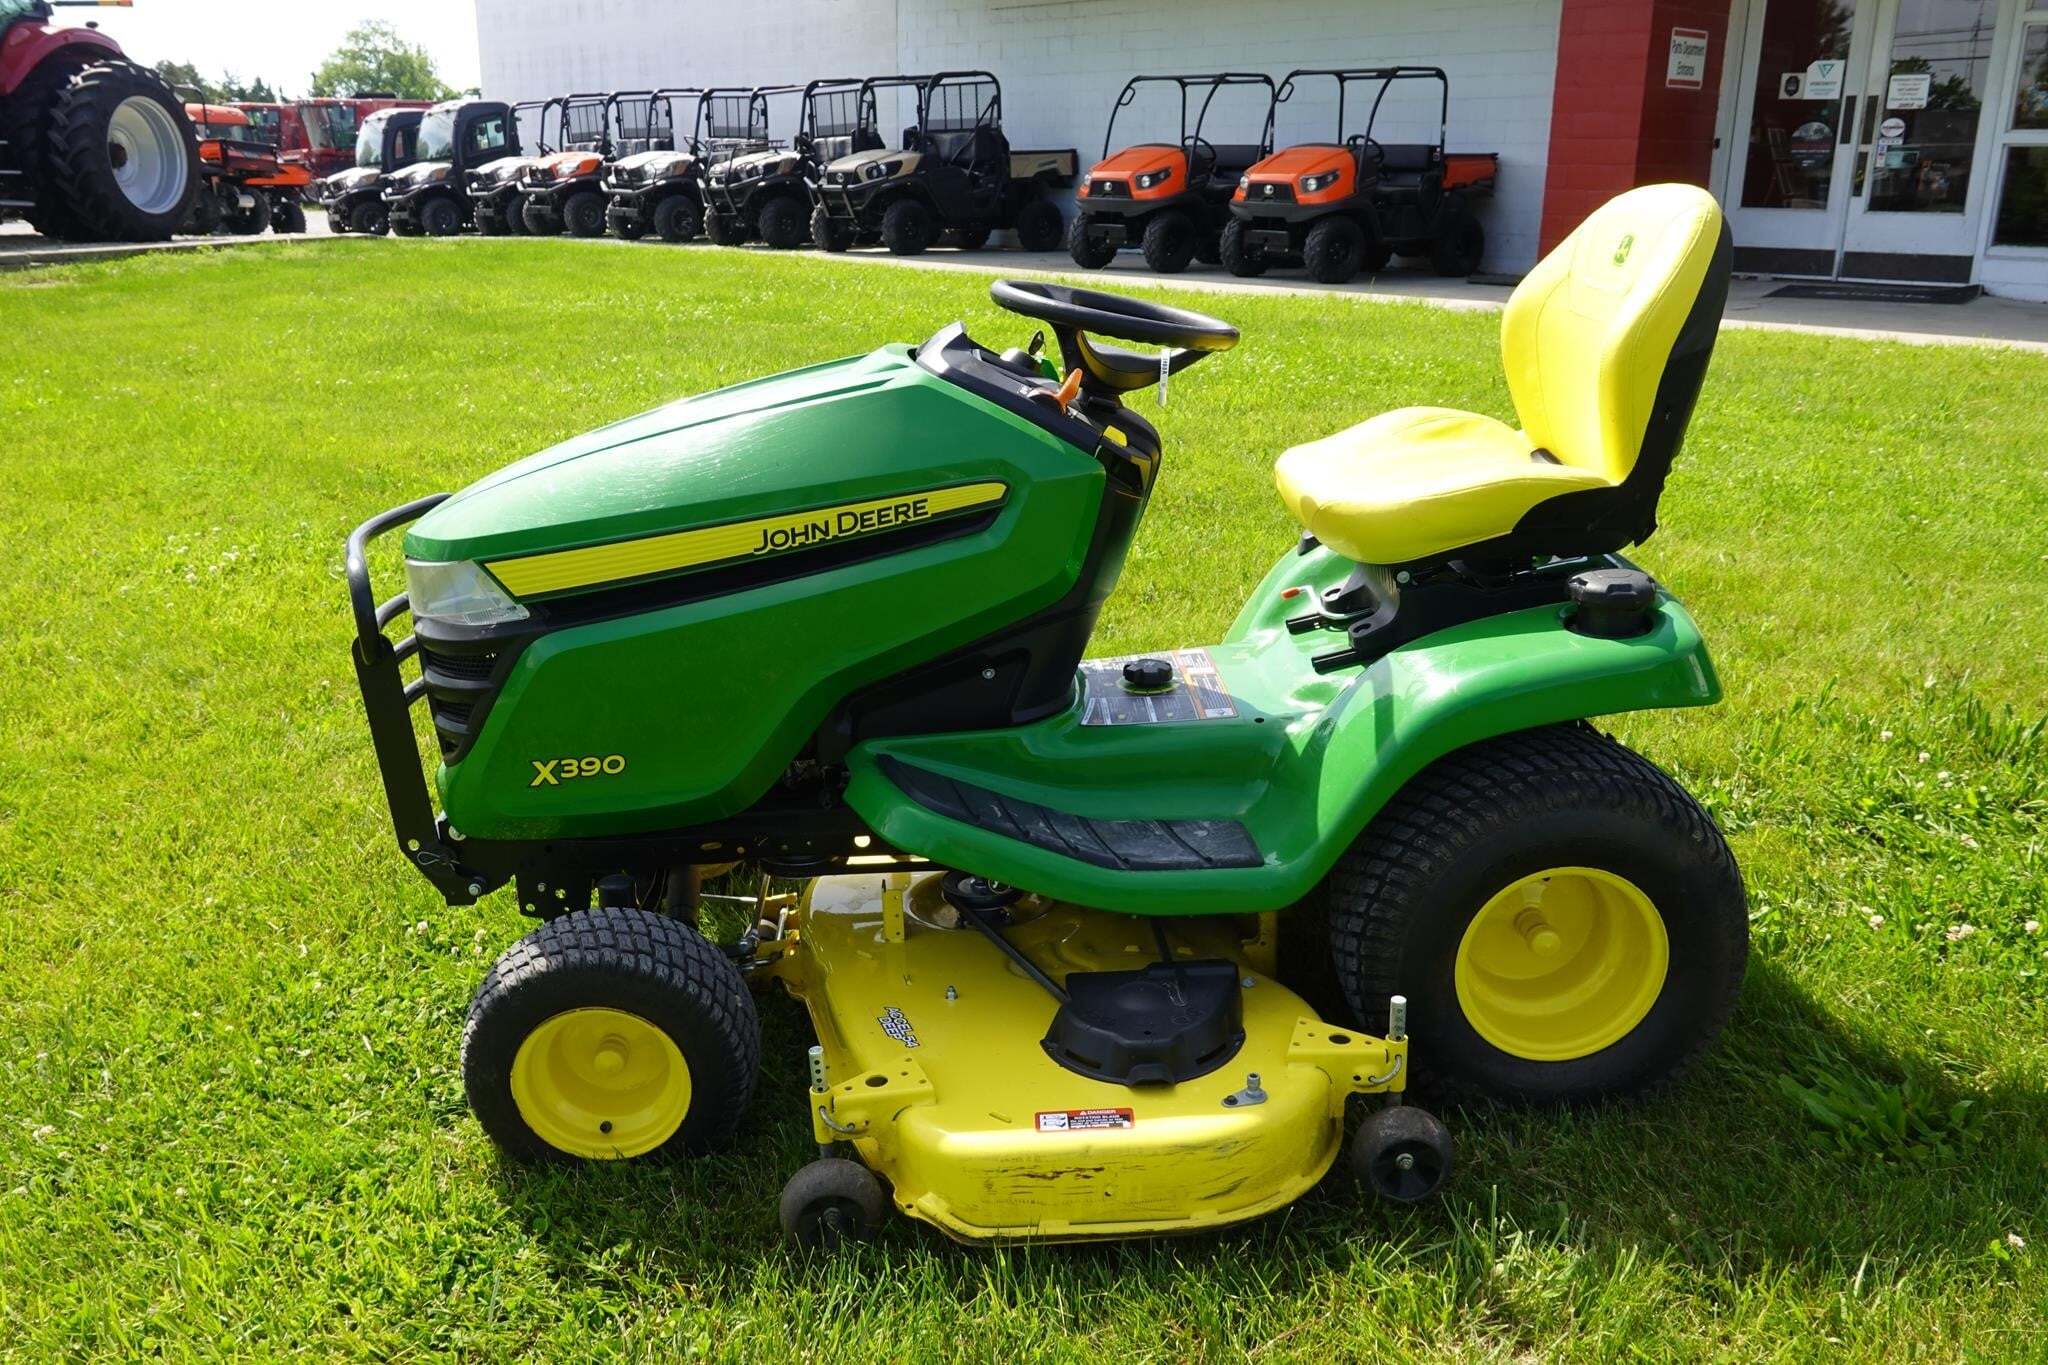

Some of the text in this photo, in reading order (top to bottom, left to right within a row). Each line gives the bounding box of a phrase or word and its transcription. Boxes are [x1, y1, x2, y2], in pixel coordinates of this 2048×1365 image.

[753, 498, 930, 554] JOHN DEERE
[530, 754, 626, 786] X390
[877, 1016, 904, 1040] DEEP
[884, 1007, 913, 1037] ACCEL
